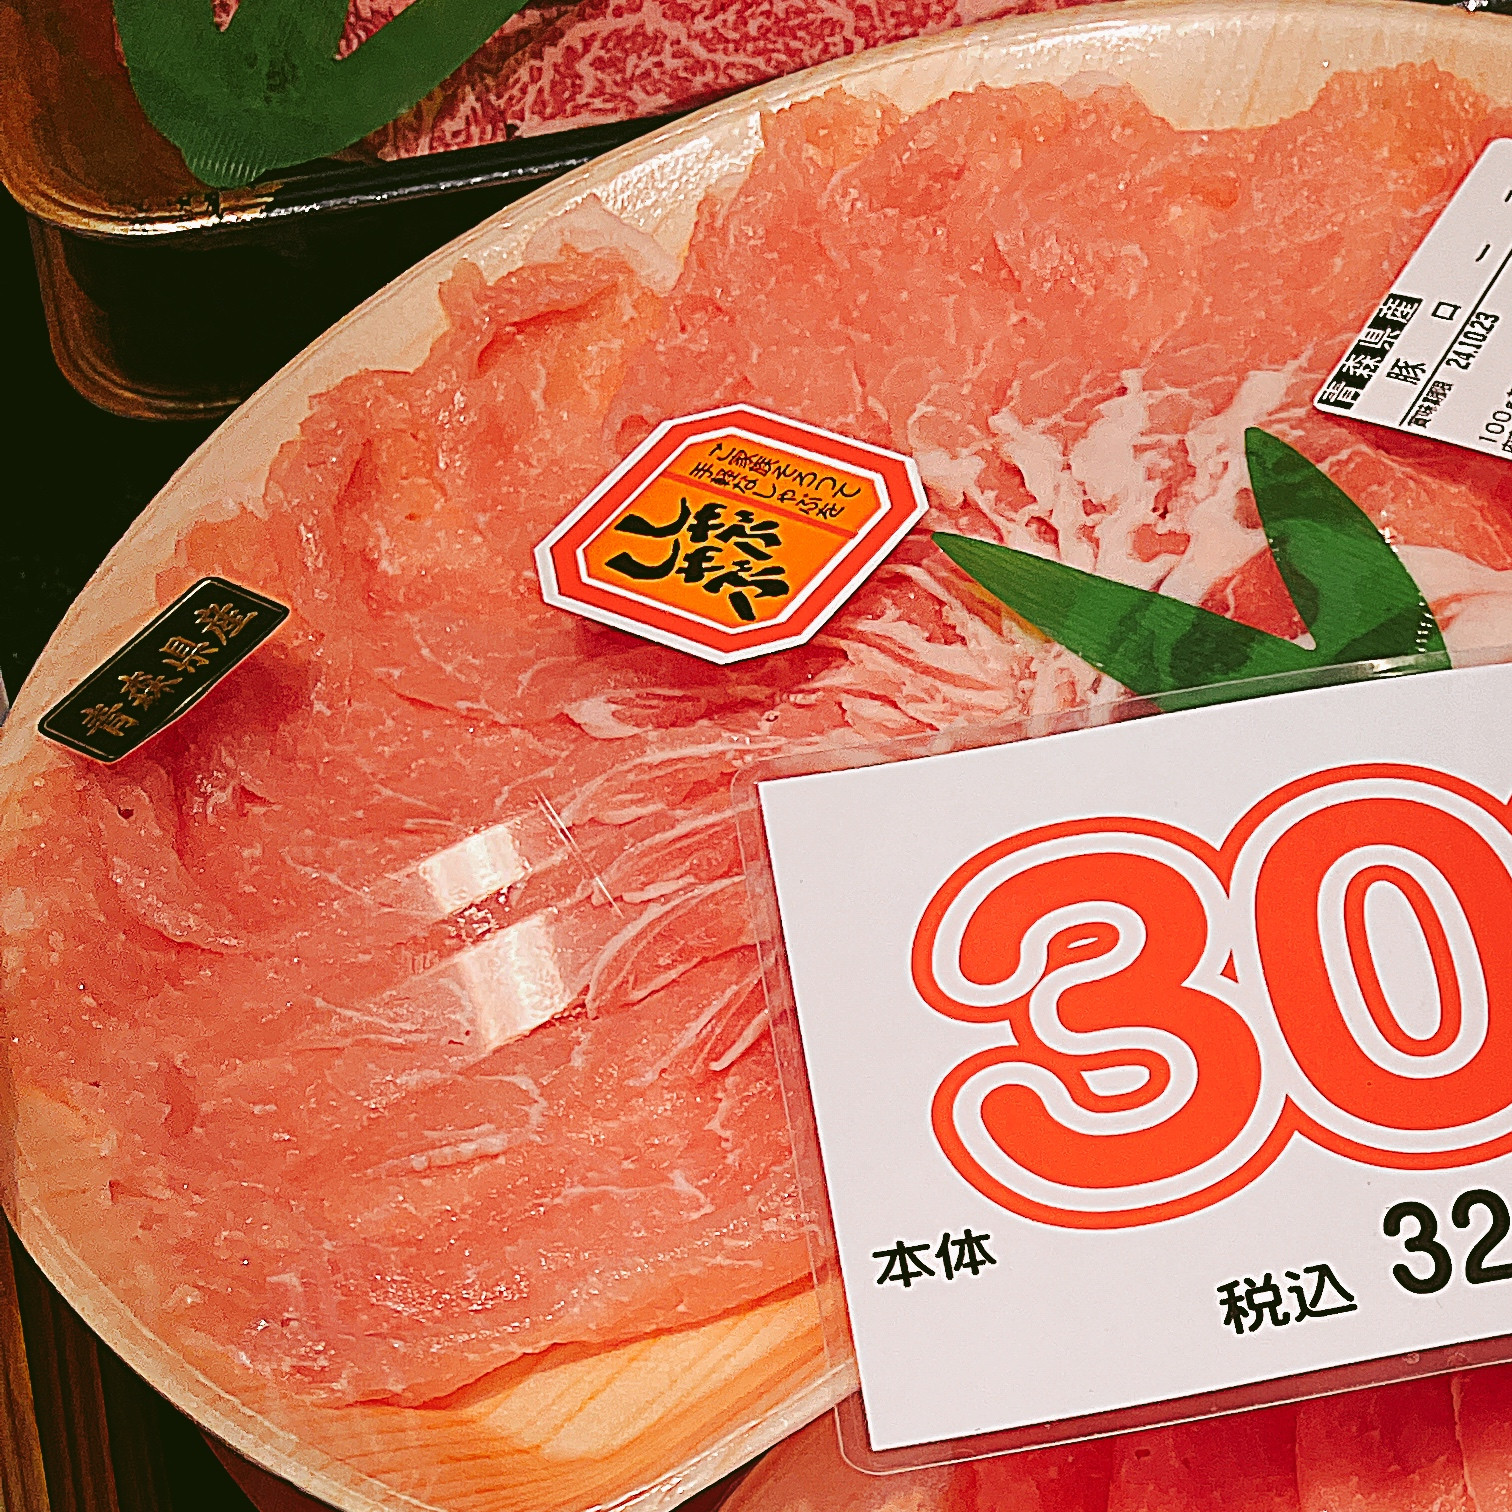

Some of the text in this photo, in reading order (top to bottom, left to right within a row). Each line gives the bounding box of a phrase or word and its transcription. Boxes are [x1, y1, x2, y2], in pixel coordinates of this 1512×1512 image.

[80, 603, 258, 737] 青森県産
[873, 1229, 998, 1288] 本体
[1218, 1265, 1358, 1333] 税込
